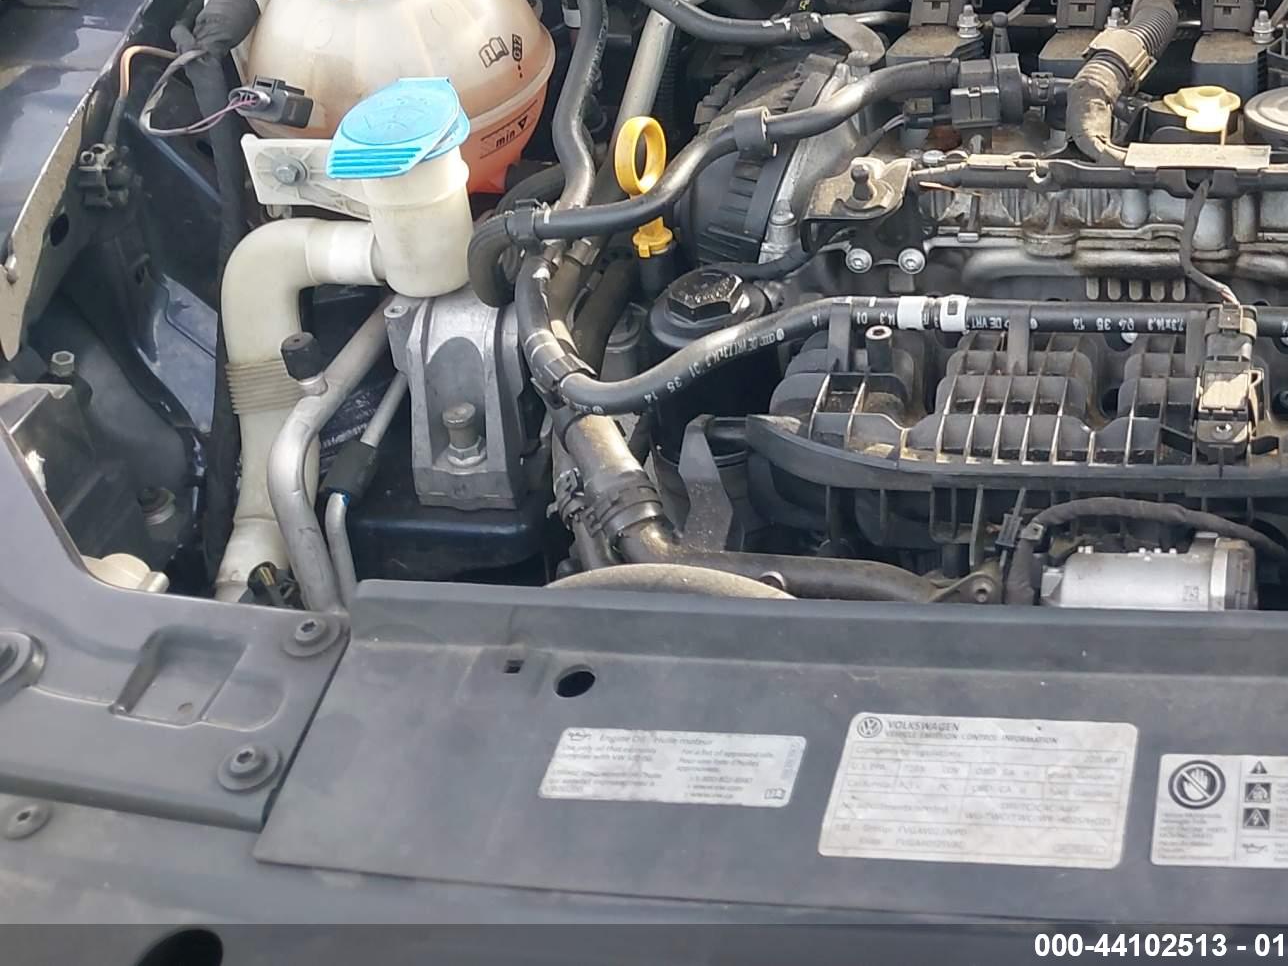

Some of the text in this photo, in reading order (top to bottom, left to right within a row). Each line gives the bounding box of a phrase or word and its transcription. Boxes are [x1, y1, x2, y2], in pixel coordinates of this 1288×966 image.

[495, 129, 516, 148] min
[887, 720, 960, 732] VOLKSWAGEN
[599, 733, 631, 744] Engine
[885, 731, 917, 739] VEHICLE
[961, 733, 998, 742] CONTROL
[1001, 734, 1058, 744] INFORMATION
